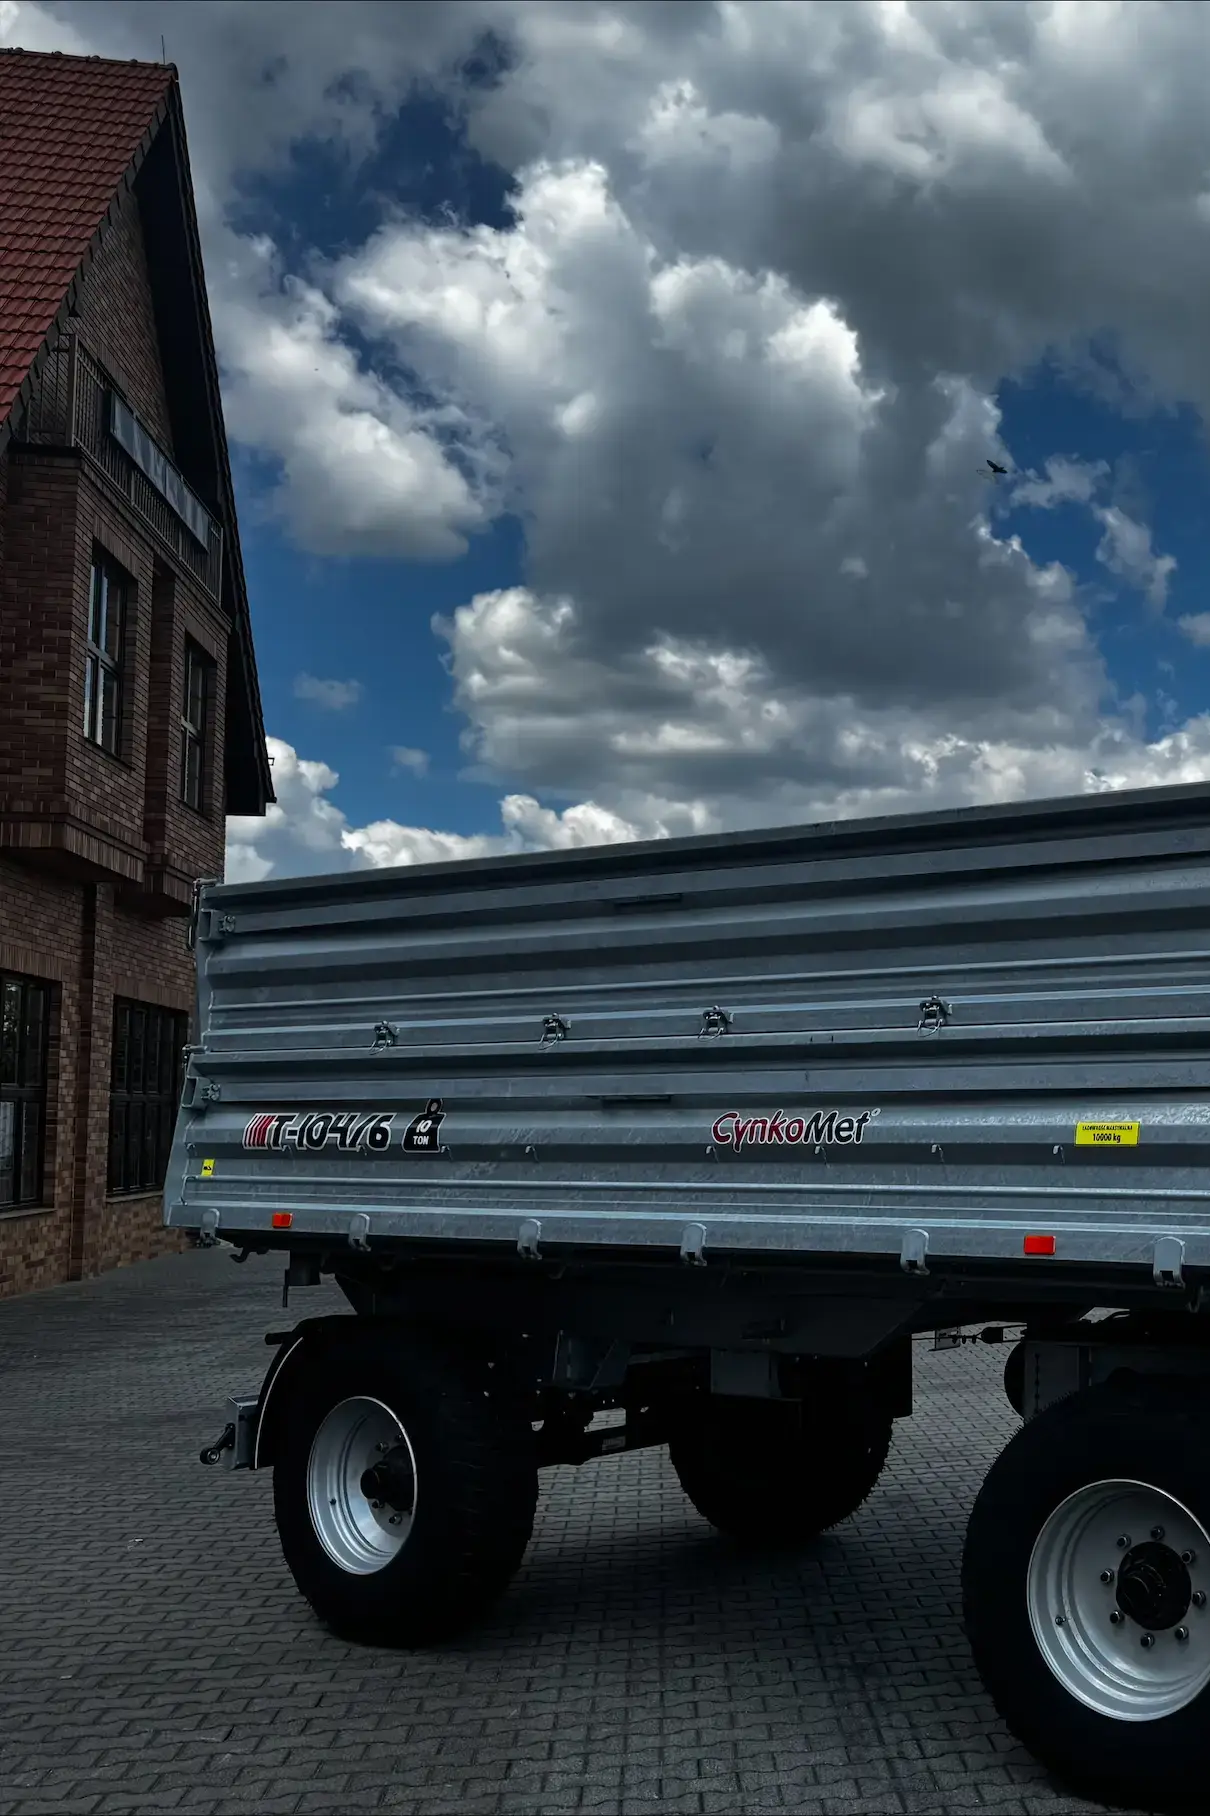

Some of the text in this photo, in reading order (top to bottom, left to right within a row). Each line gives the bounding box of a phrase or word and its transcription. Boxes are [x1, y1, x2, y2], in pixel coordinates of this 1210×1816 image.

[416, 1119, 432, 1133] 10
[413, 1135, 430, 1145] TON
[1093, 1133, 1121, 1143] 10000 kg
